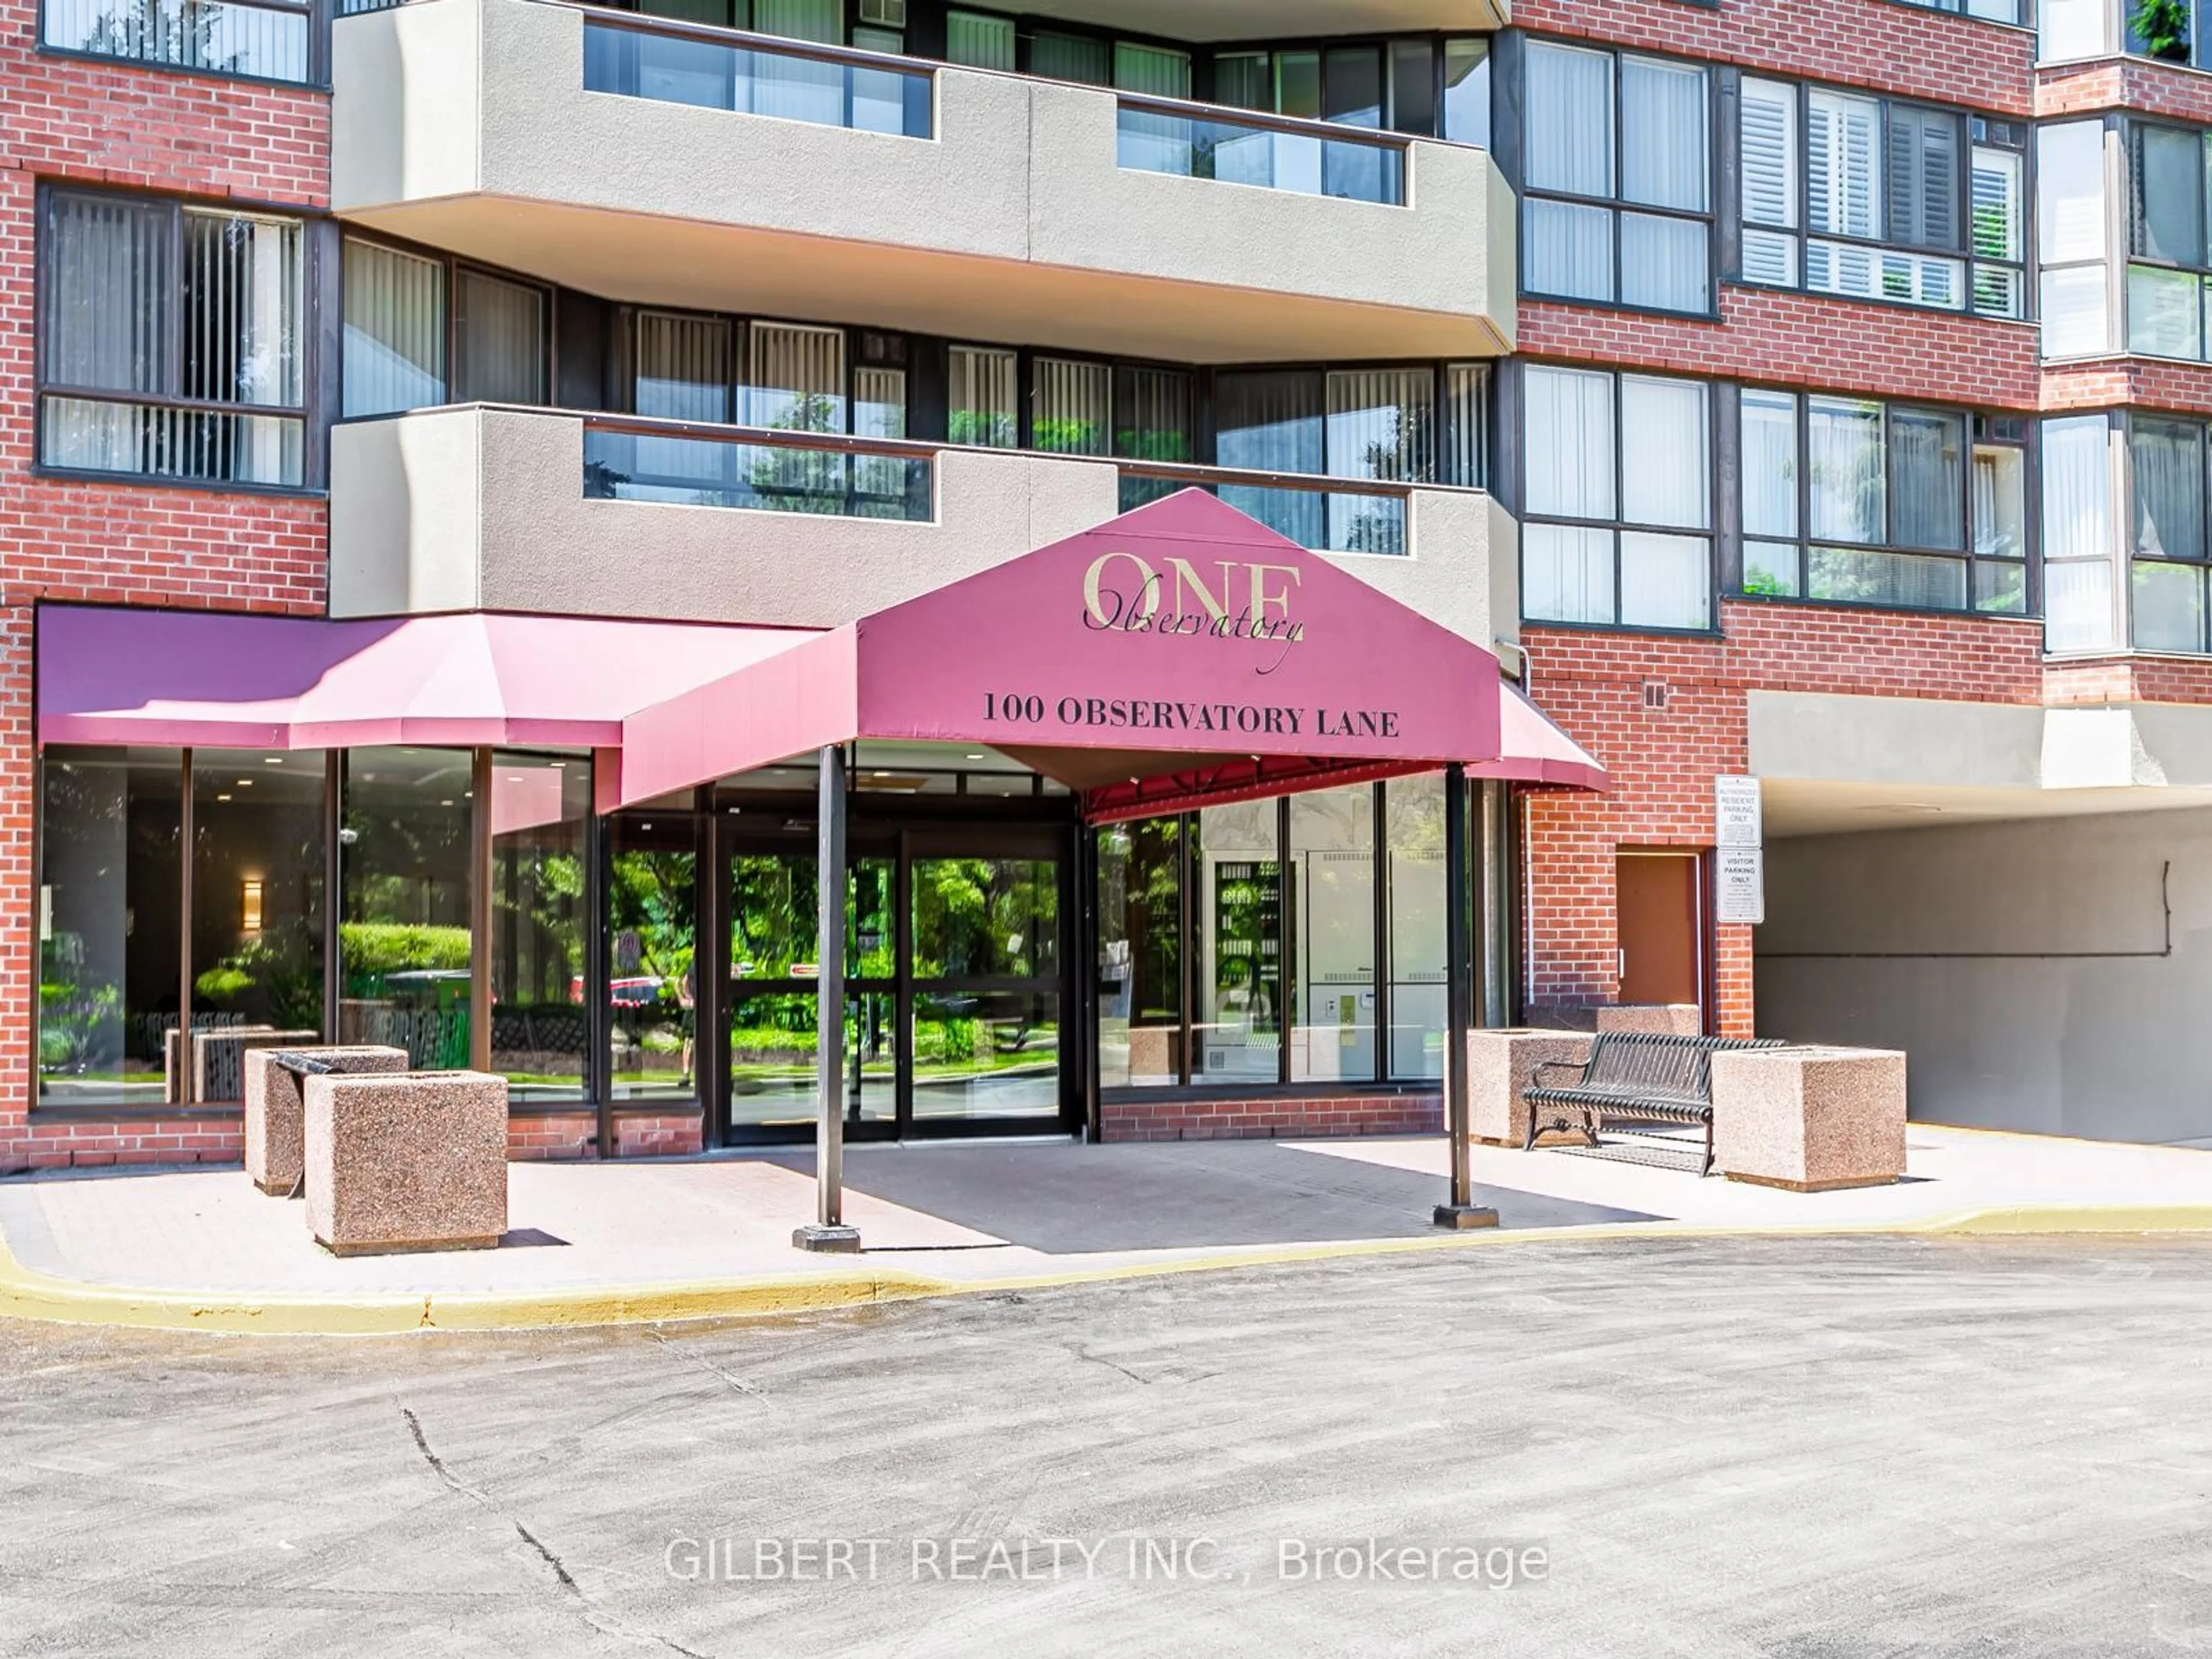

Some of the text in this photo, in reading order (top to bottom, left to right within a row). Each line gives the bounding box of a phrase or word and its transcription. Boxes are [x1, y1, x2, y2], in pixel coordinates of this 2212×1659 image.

[1082, 573, 1304, 676] Observatory
[1083, 551, 1304, 642] ONE
[982, 692, 1399, 738] 100 OBSERVATORY LANE
